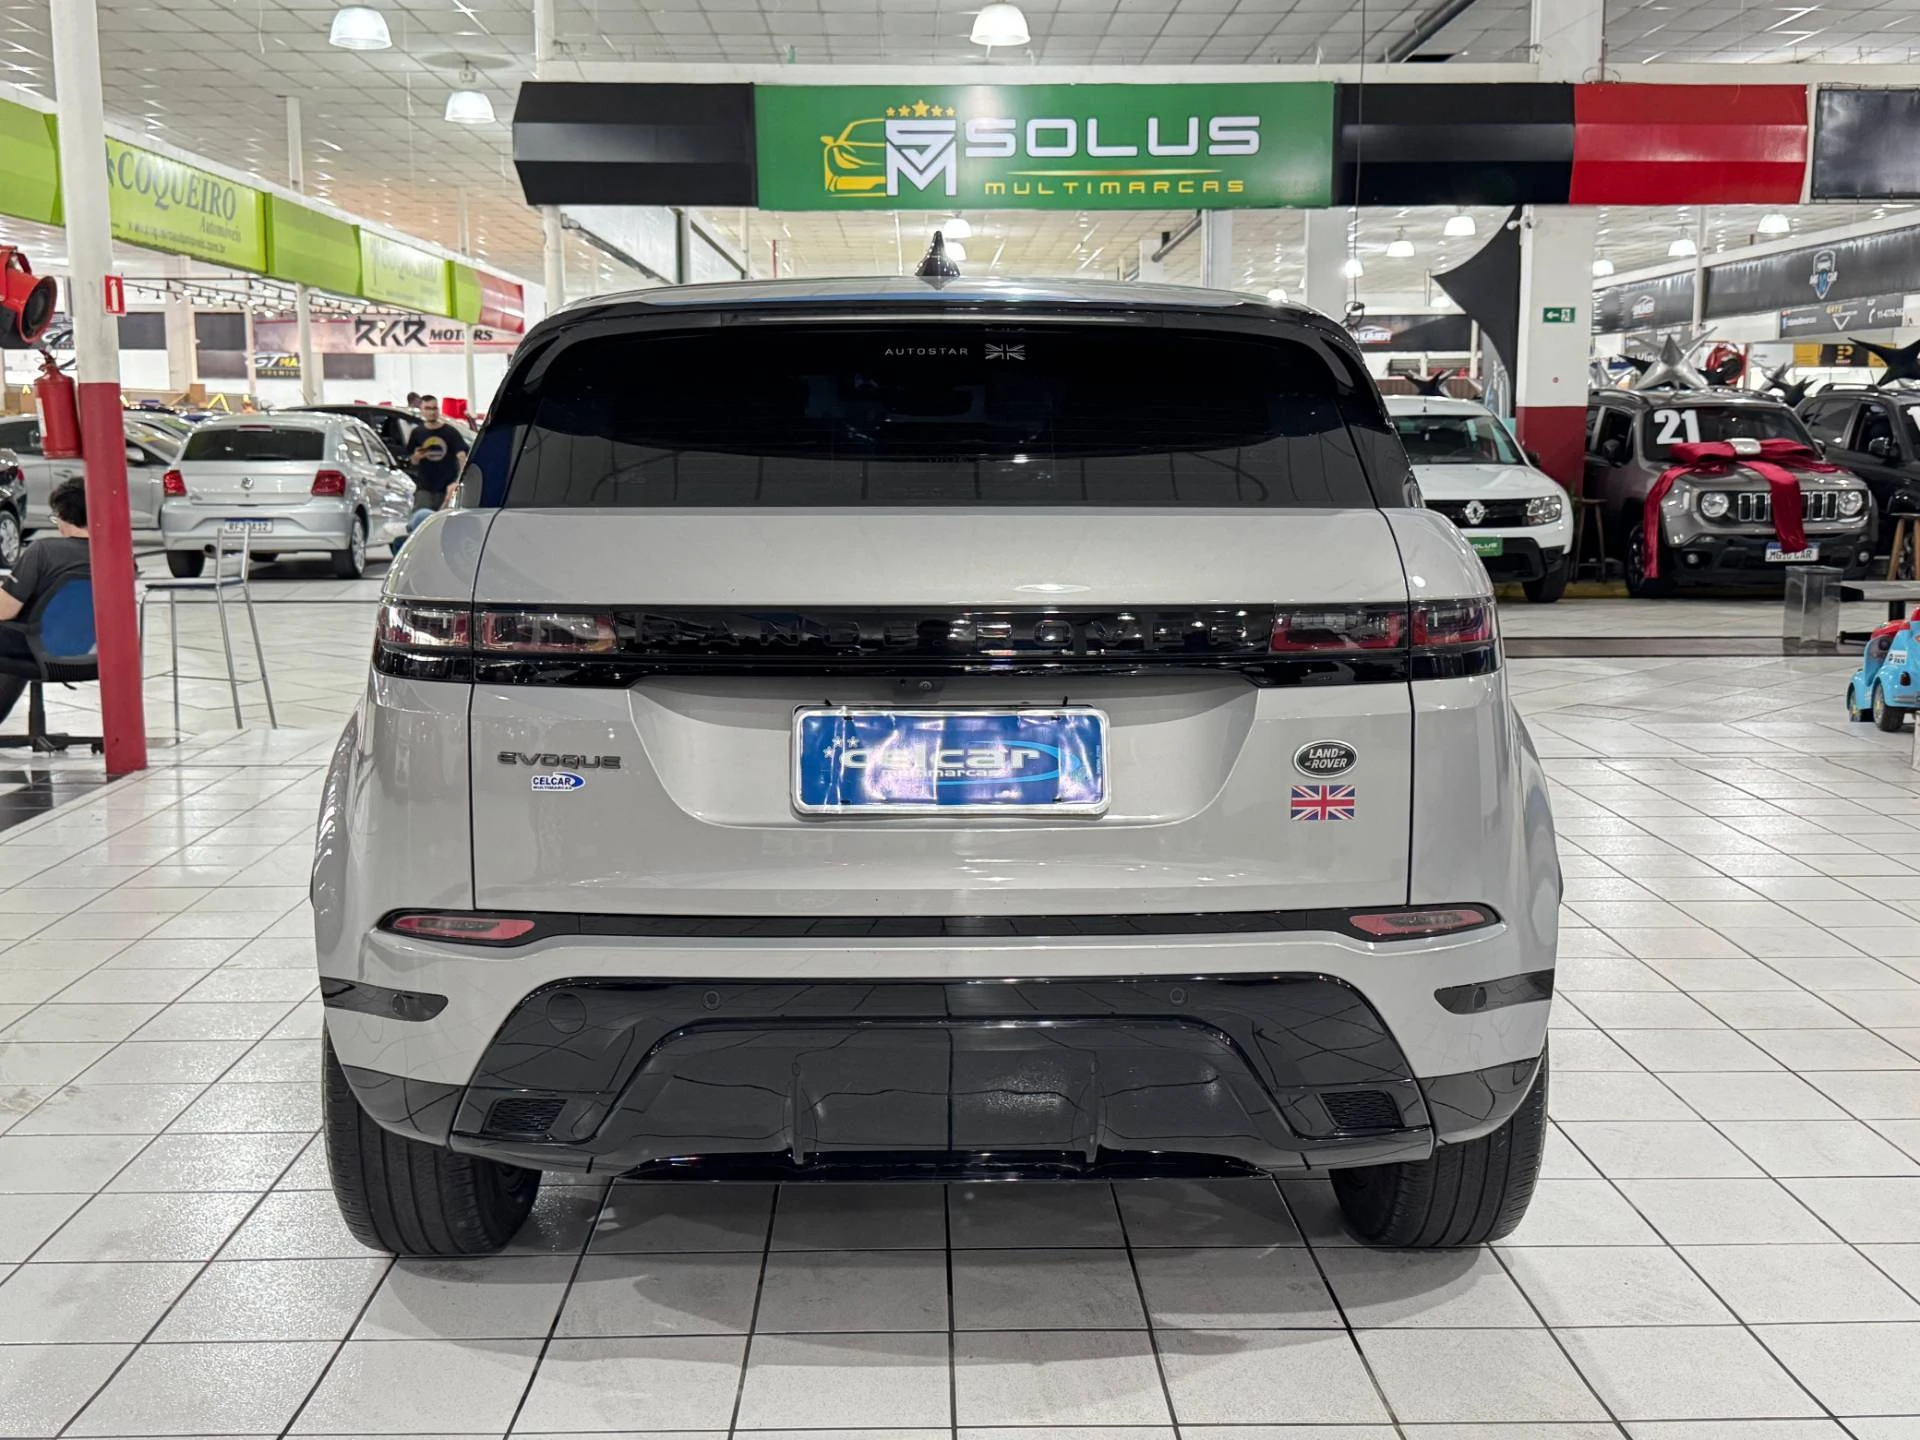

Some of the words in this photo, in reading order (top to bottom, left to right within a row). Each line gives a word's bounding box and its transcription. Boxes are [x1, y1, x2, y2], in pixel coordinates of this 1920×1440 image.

[965, 116, 1262, 158] SOLUS
[118, 151, 237, 221] COQUEIRO
[985, 181, 1245, 195] MULTIMARCAS
[429, 329, 493, 342] MOTRS
[884, 347, 968, 357] AUTOSTAR
[1654, 409, 1700, 444] 21
[974, 619, 1248, 647] ROVER
[497, 751, 622, 769] EVOQUE
[1308, 748, 1339, 759] LAND
[1310, 758, 1348, 769] ROVER
[532, 776, 572, 786] CELCAR
